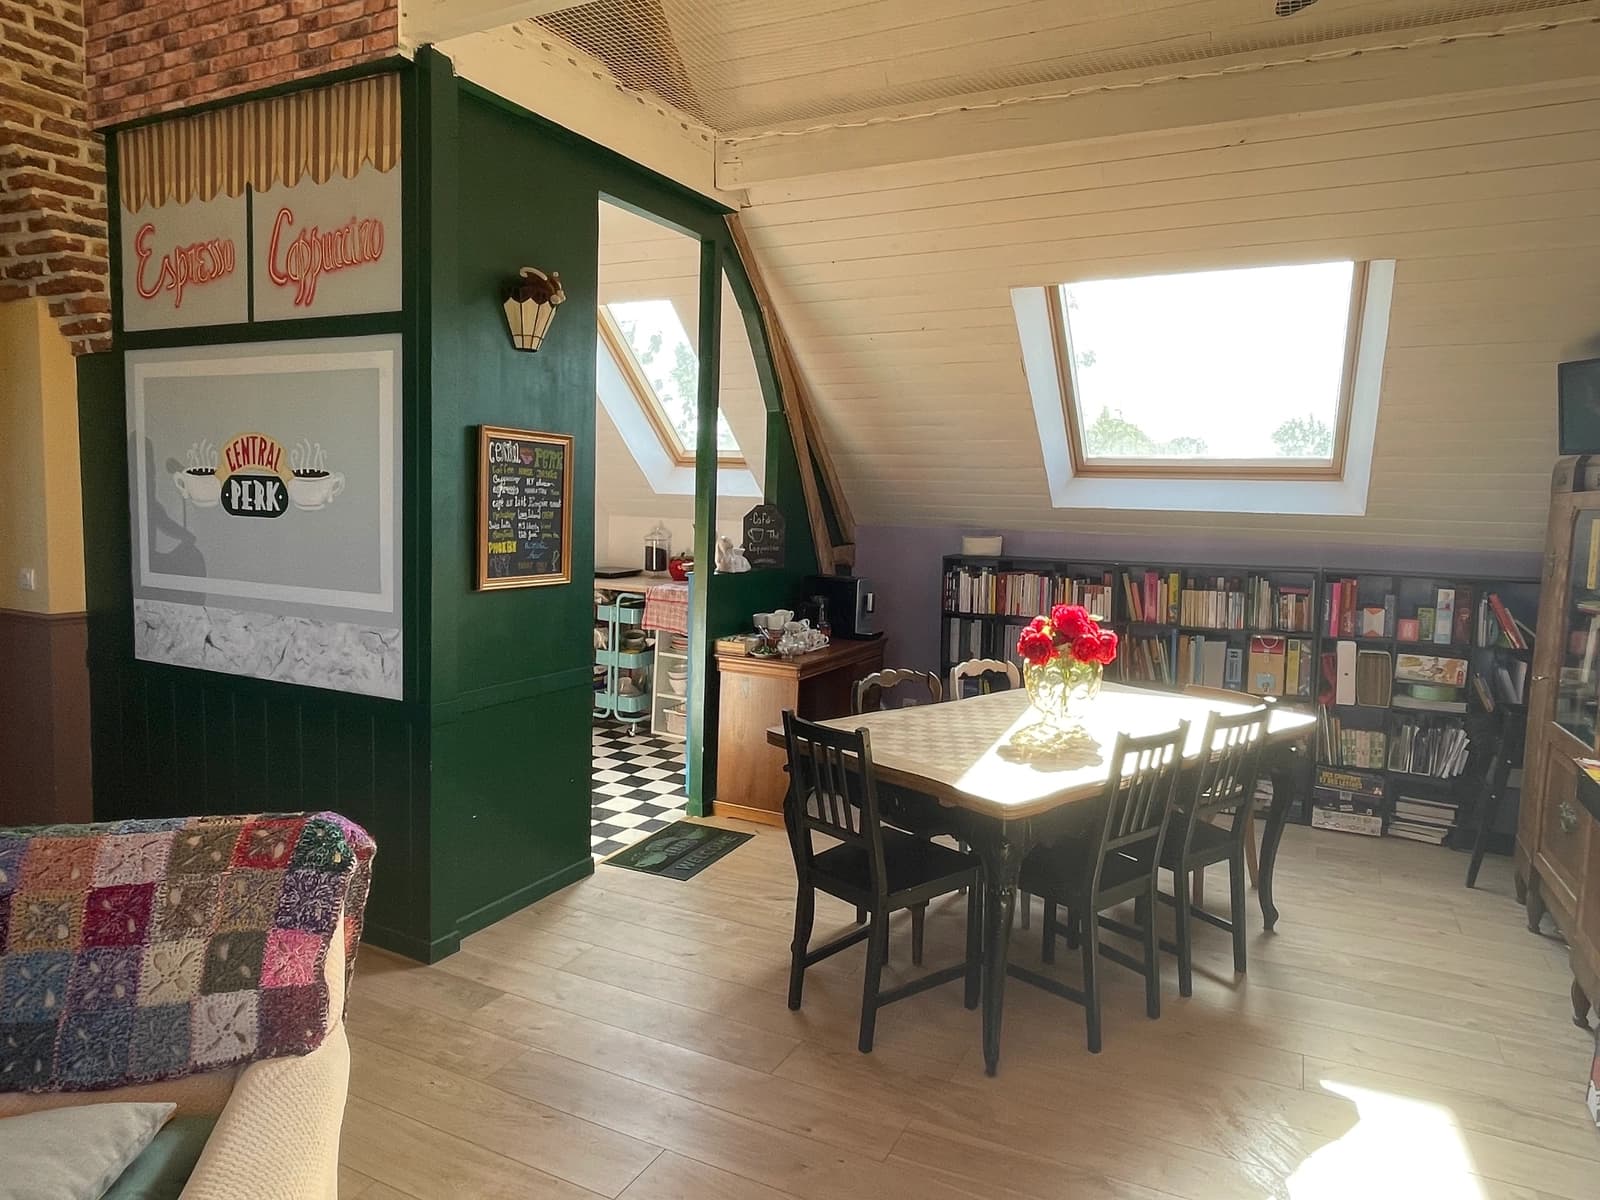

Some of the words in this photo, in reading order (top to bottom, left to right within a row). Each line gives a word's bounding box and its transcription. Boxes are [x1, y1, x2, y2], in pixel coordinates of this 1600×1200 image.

[135, 223, 236, 308] Espresso
[269, 207, 384, 306] Cappuccino
[225, 435, 282, 473] CENTRAL
[230, 479, 281, 512] PERK
[675, 834, 738, 871] WELCOME
